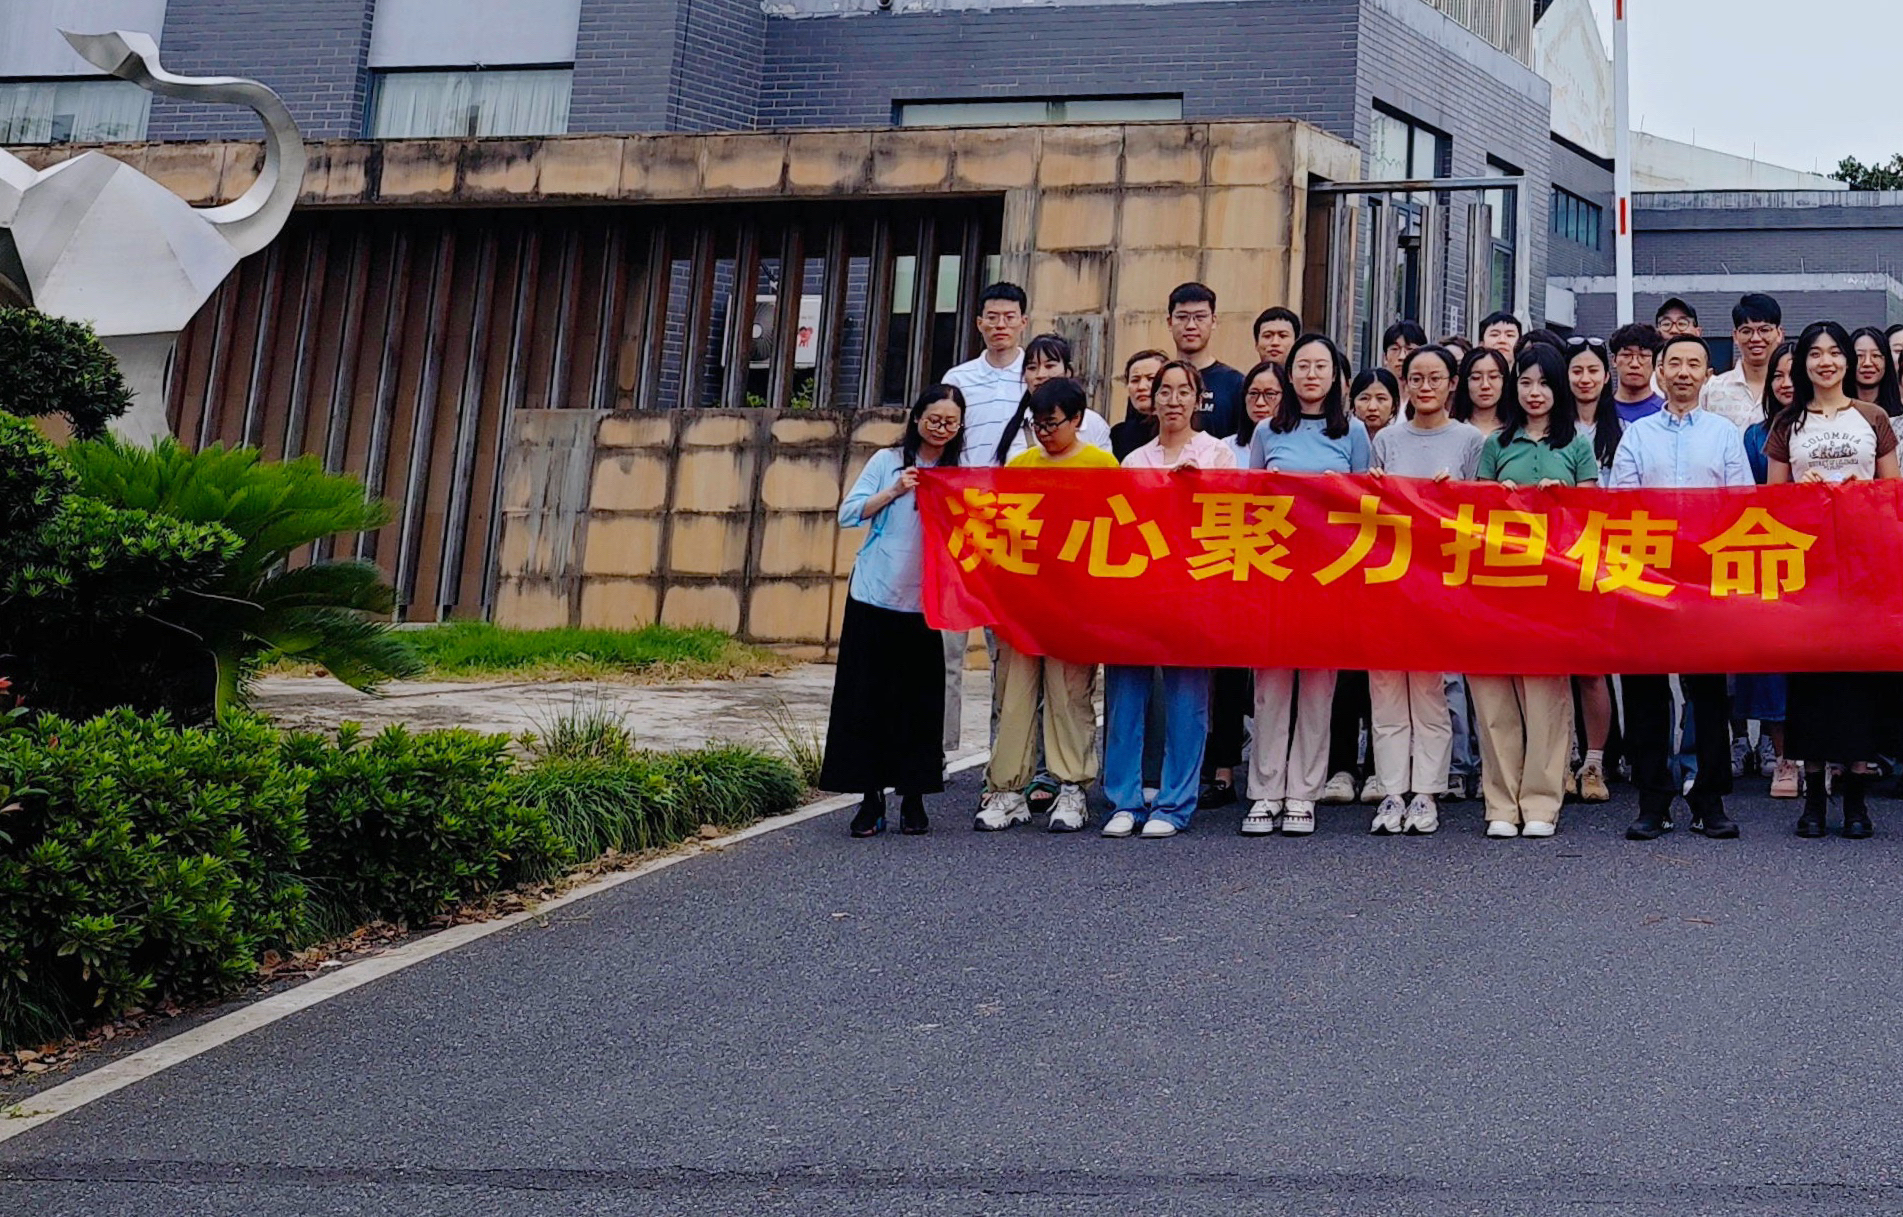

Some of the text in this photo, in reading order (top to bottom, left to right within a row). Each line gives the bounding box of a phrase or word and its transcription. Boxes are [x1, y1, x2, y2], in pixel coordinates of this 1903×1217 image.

[946, 488, 1817, 602] 凝心聚力担使命
